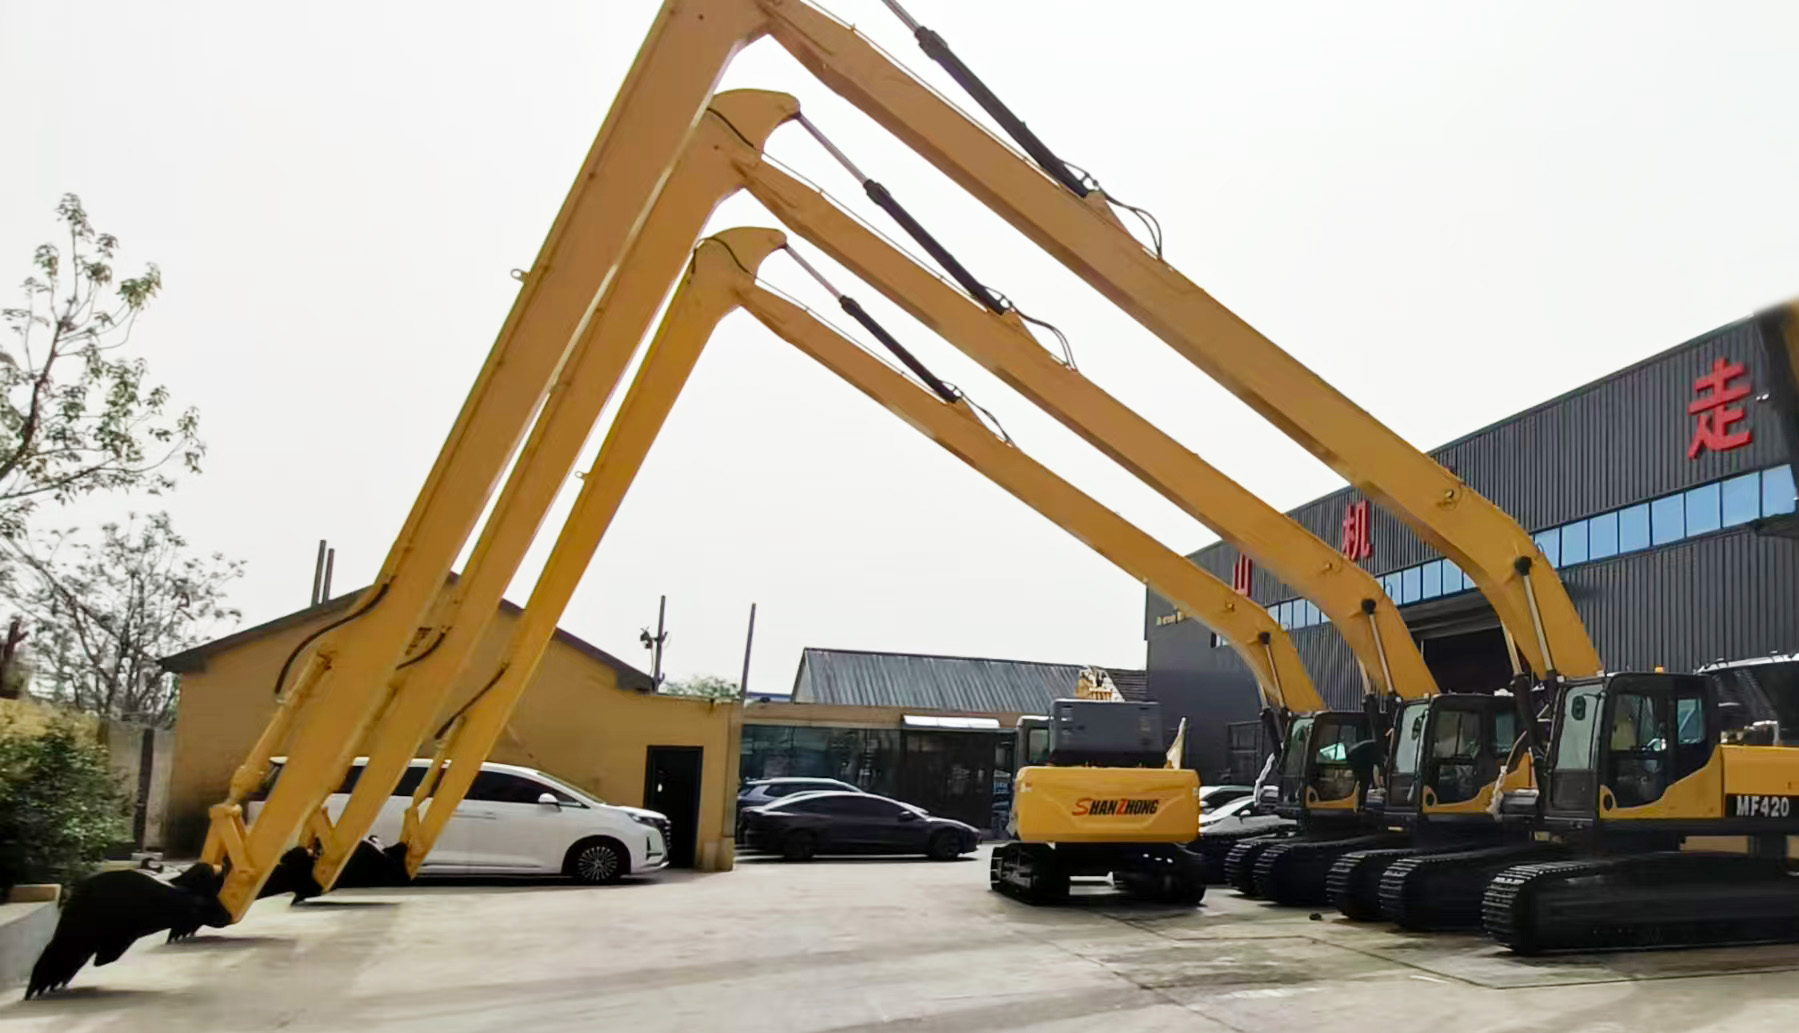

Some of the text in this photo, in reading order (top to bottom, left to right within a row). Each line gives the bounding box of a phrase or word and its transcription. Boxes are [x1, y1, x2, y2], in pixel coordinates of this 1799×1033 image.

[1687, 356, 1752, 461] 走
[1071, 798, 1160, 816] SHANZHONG
[1735, 795, 1790, 817] MF420
